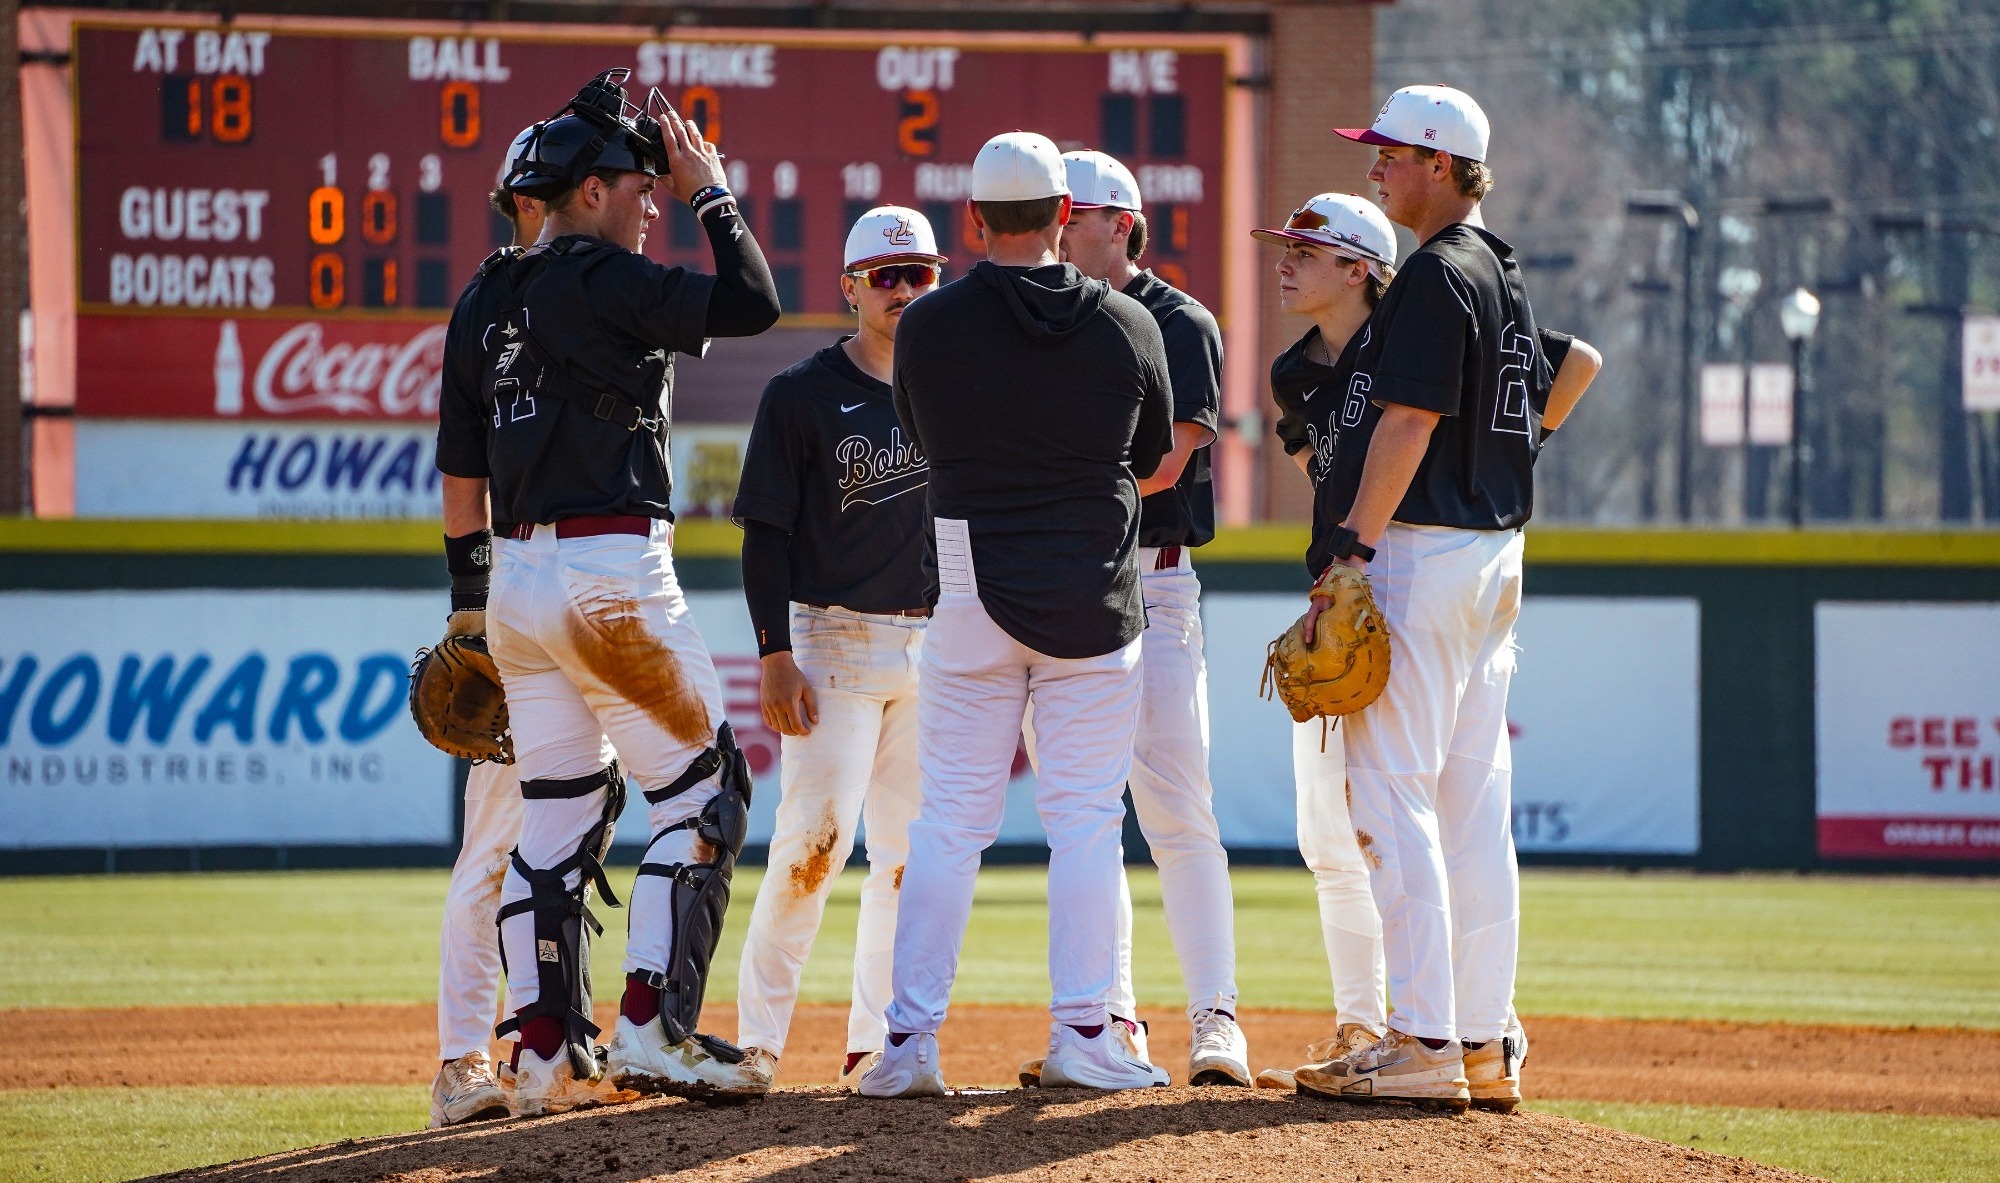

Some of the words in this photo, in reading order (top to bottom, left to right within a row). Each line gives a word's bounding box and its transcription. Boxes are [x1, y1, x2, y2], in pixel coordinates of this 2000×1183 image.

[133, 28, 184, 73] AT
[194, 30, 271, 76] BAT
[408, 36, 511, 82] BALL
[636, 42, 777, 88] STRIKE
[876, 46, 960, 90] OUT
[187, 74, 252, 141] 18
[440, 80, 480, 148] 0
[899, 88, 939, 155] 2
[319, 152, 338, 186] 1
[367, 153, 391, 190] 2
[419, 154, 443, 192] 3
[120, 186, 270, 242] GUEST
[309, 187, 344, 244] 0
[363, 190, 396, 244] 0
[110, 254, 275, 310] BOBCATS
[310, 253, 344, 308] 0
[1342, 371, 1372, 428] 6
[1888, 716, 1979, 748] SEE
[1921, 756, 2000, 791] TH
